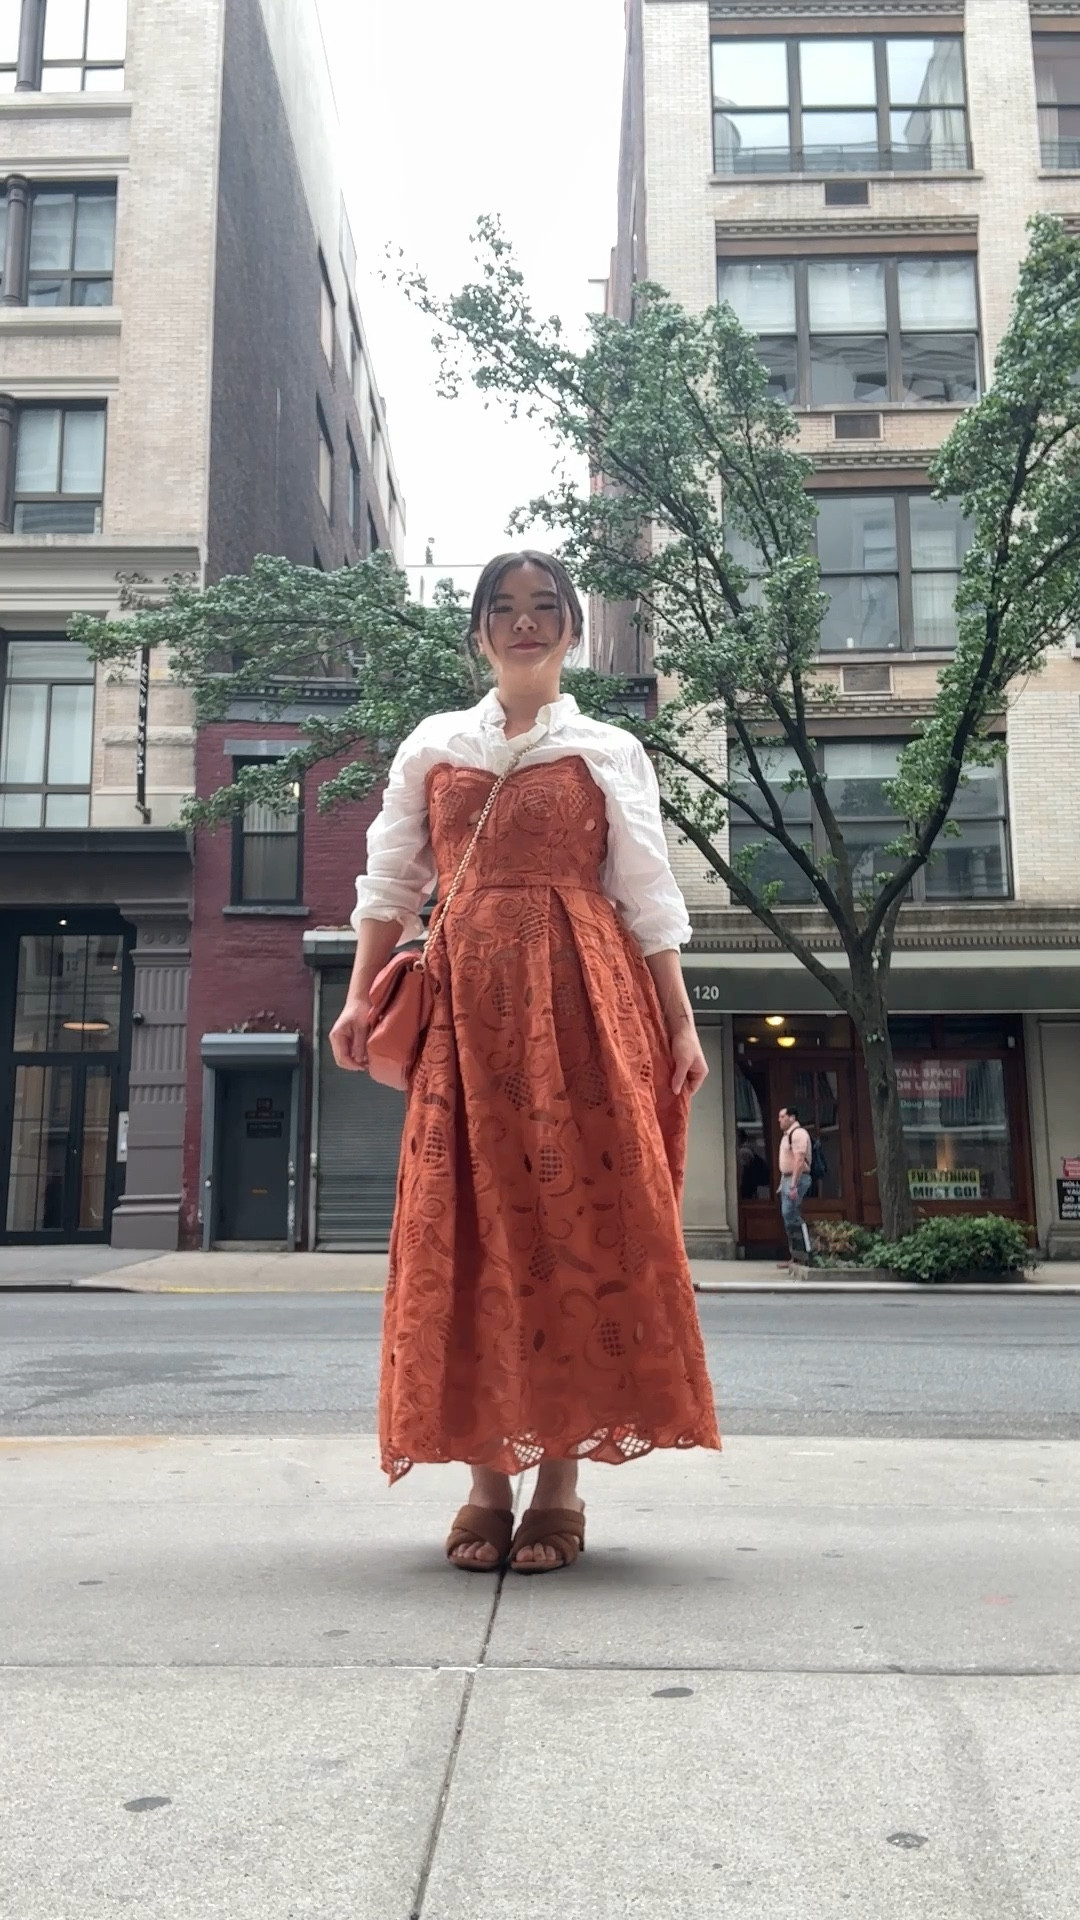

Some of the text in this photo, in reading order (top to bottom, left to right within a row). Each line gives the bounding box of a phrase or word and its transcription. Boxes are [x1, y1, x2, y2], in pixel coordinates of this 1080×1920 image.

[693, 985, 720, 1000] 120
[922, 1068, 962, 1079] SPACE
[914, 1081, 952, 1091] LEASE
[910, 1168, 978, 1183] EVERYTHING
[912, 1186, 978, 1198] MUST GO!
